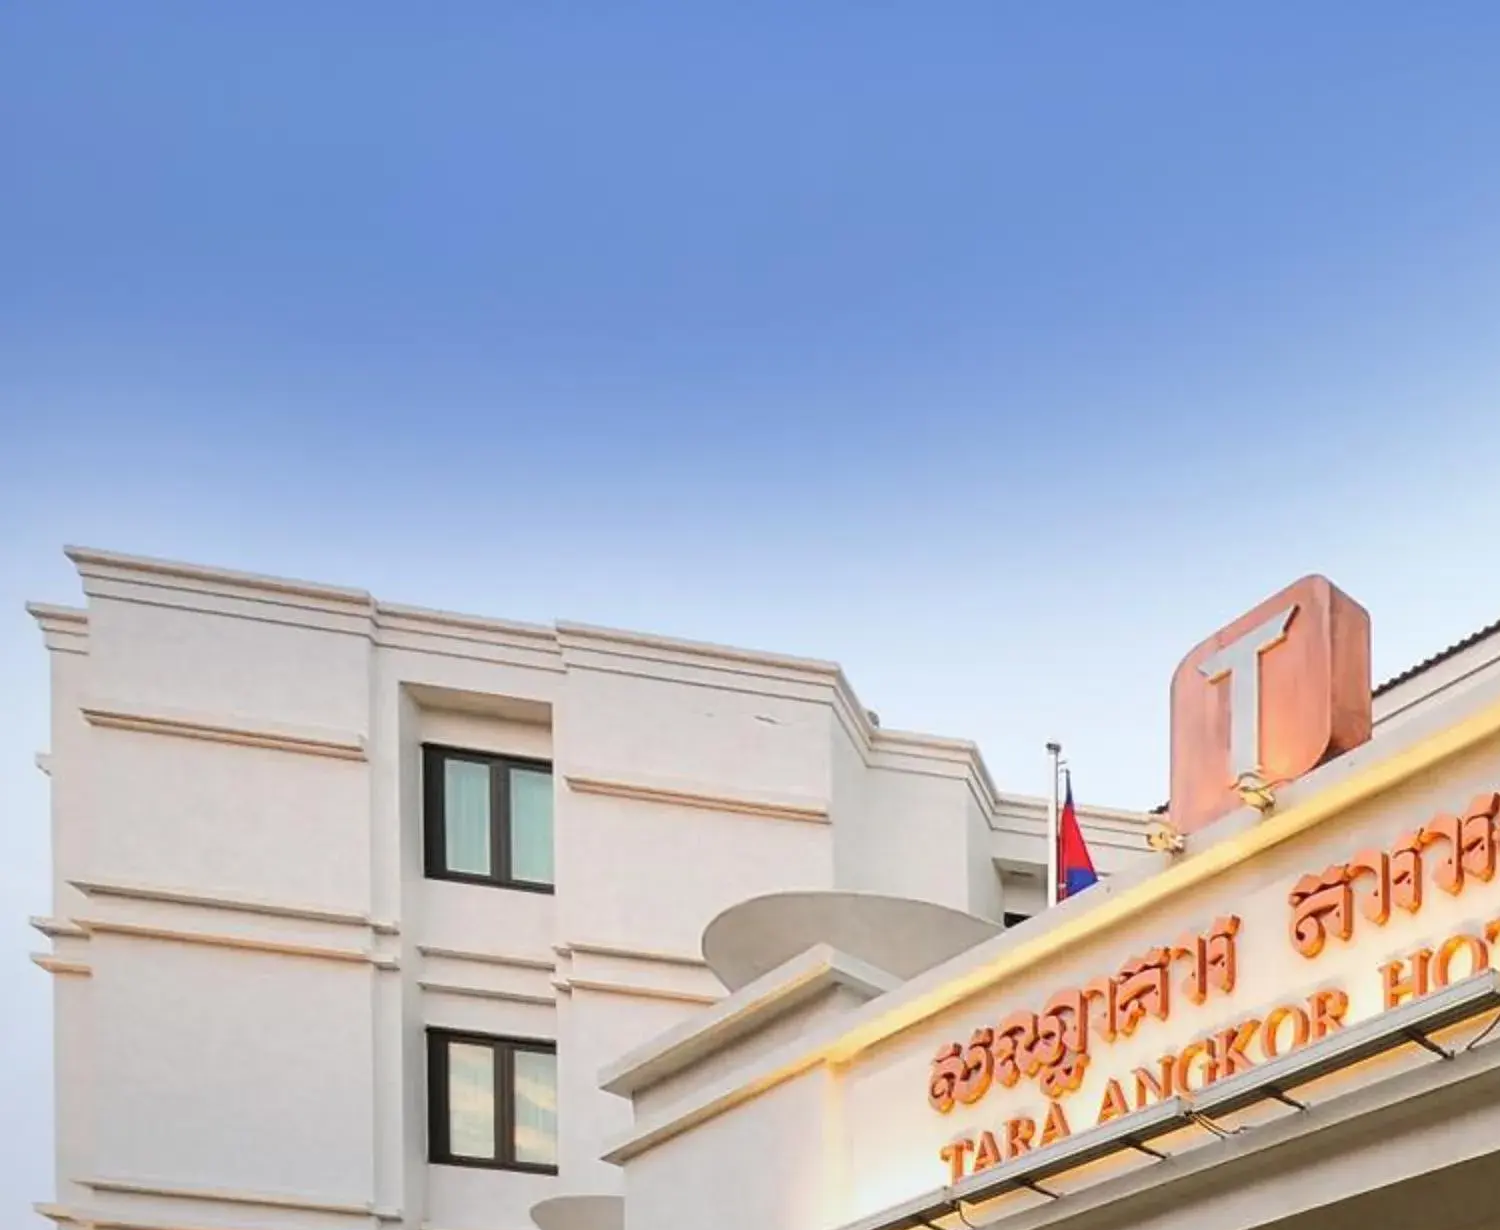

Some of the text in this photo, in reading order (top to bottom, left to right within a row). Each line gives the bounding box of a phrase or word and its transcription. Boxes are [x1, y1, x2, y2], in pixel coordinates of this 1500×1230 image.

[1196, 603, 1300, 776] T
[939, 1101, 1071, 1184] TARA
[1097, 988, 1349, 1124] ANGKOR
